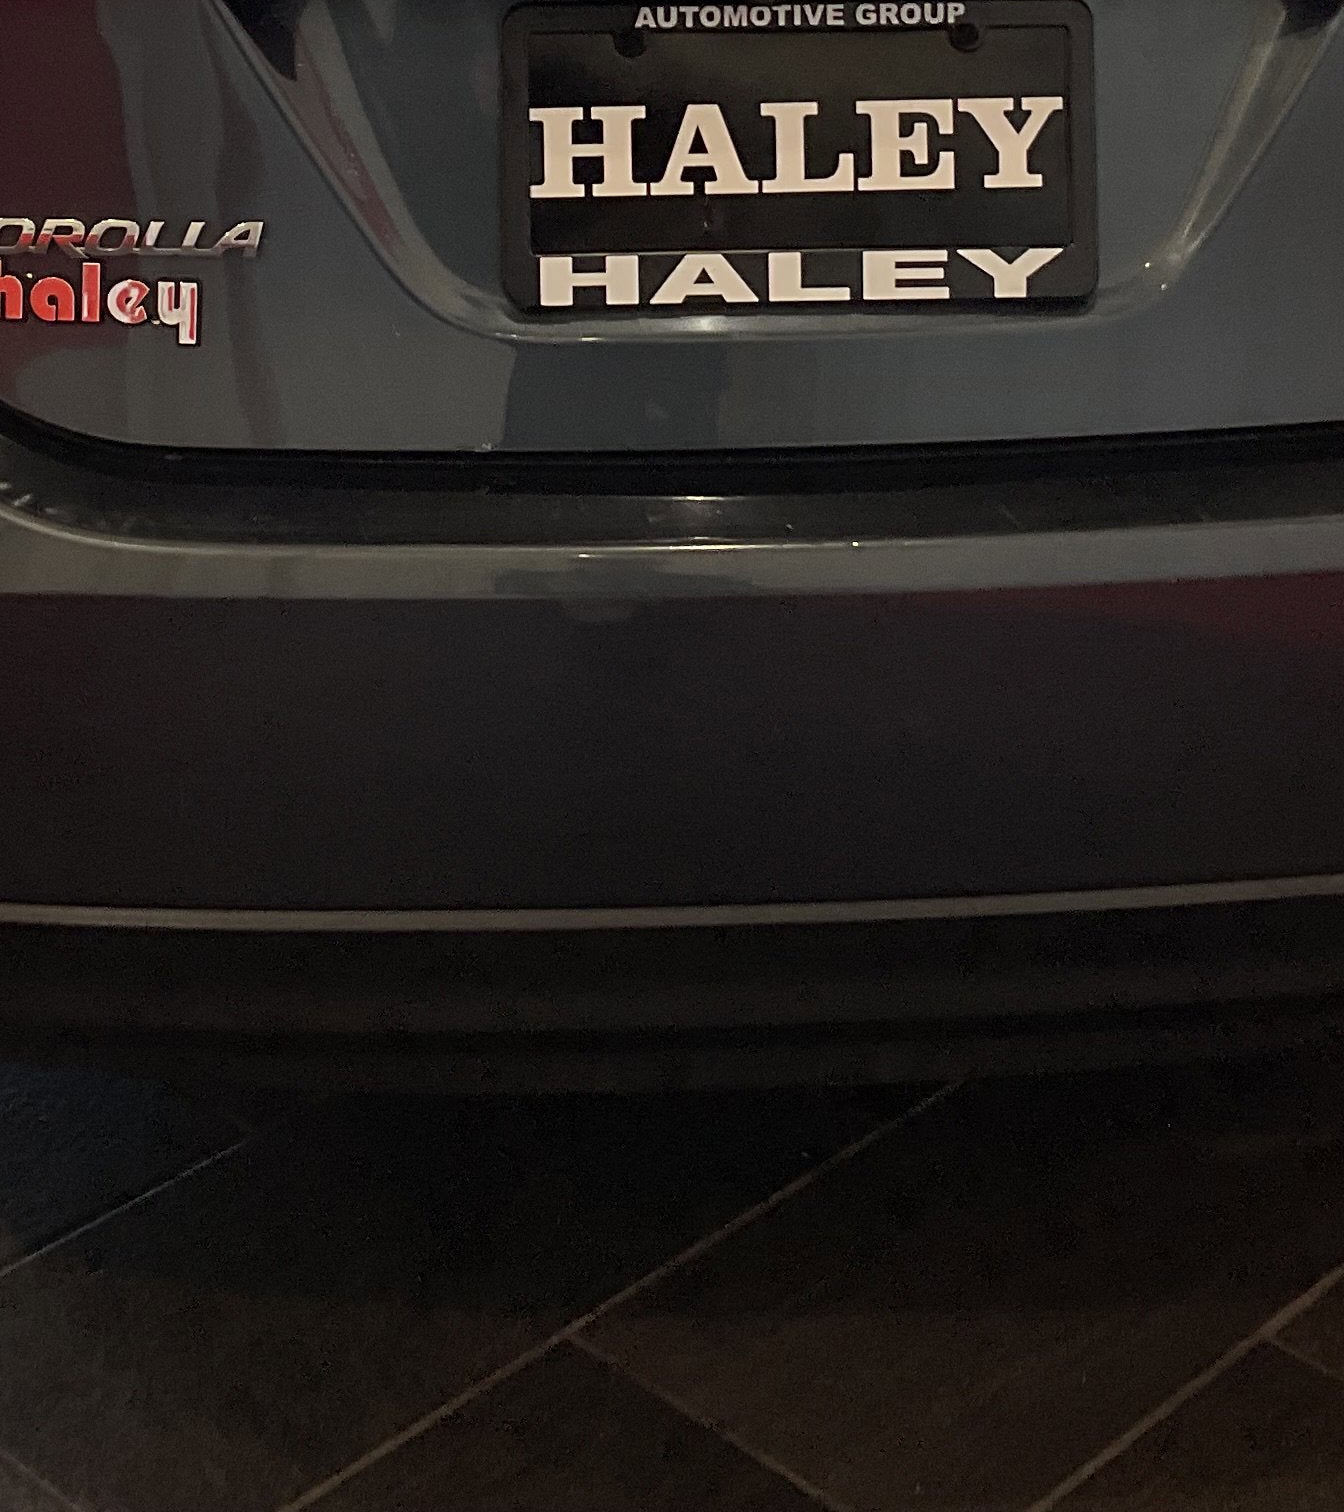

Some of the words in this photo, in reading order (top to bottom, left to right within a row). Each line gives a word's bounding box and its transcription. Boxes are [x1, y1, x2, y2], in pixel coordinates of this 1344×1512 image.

[635, 3, 844, 30] AUTOMOTIVE
[854, 1, 966, 27] GROUP
[528, 96, 1064, 199] HALEY
[539, 247, 1064, 306] HALEY
